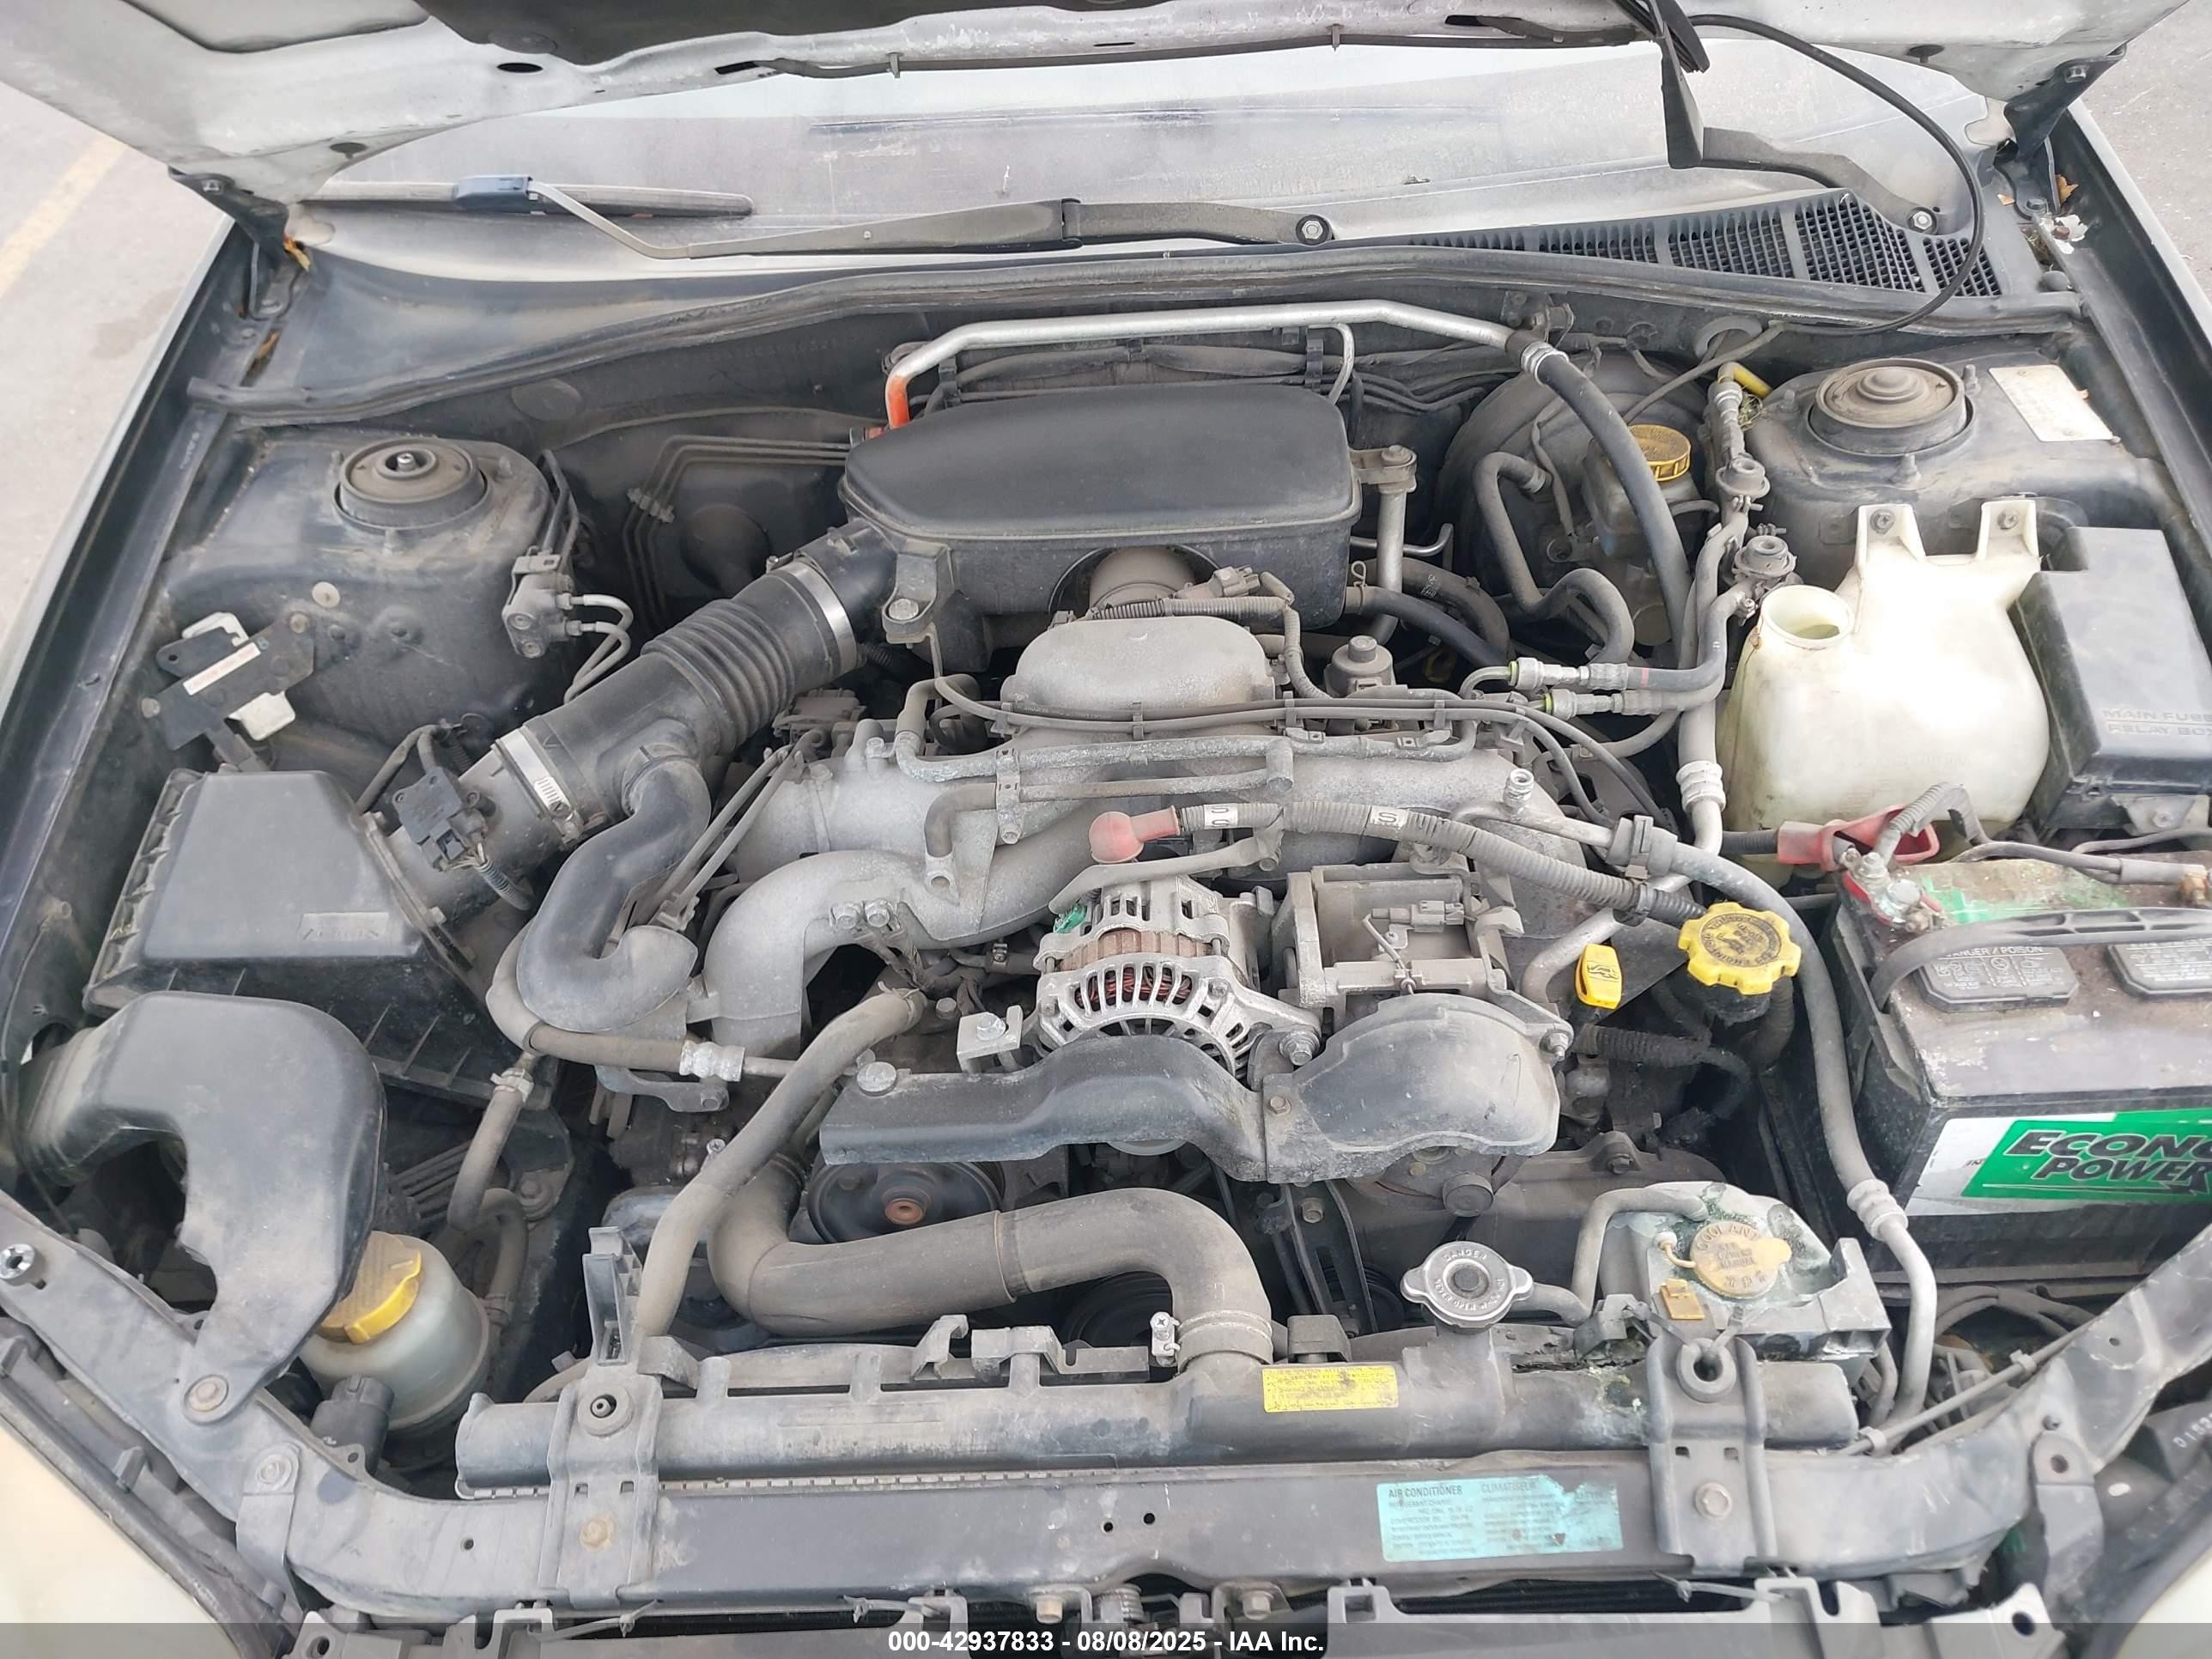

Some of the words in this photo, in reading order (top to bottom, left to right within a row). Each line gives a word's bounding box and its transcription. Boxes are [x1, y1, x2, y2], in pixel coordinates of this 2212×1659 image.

[2102, 708, 2157, 720] MAIN
[2108, 723, 2172, 735] RELAY
[2002, 945, 2044, 955] POISON
[1696, 1224, 1760, 1251] COOLANT
[1443, 1249, 1487, 1261] DANGER
[1433, 1278, 1454, 1303] NEVER
[1454, 1300, 1477, 1311] OPEN
[1389, 1488, 1402, 1498] AIR
[1405, 1485, 1463, 1498] CONDITIONER
